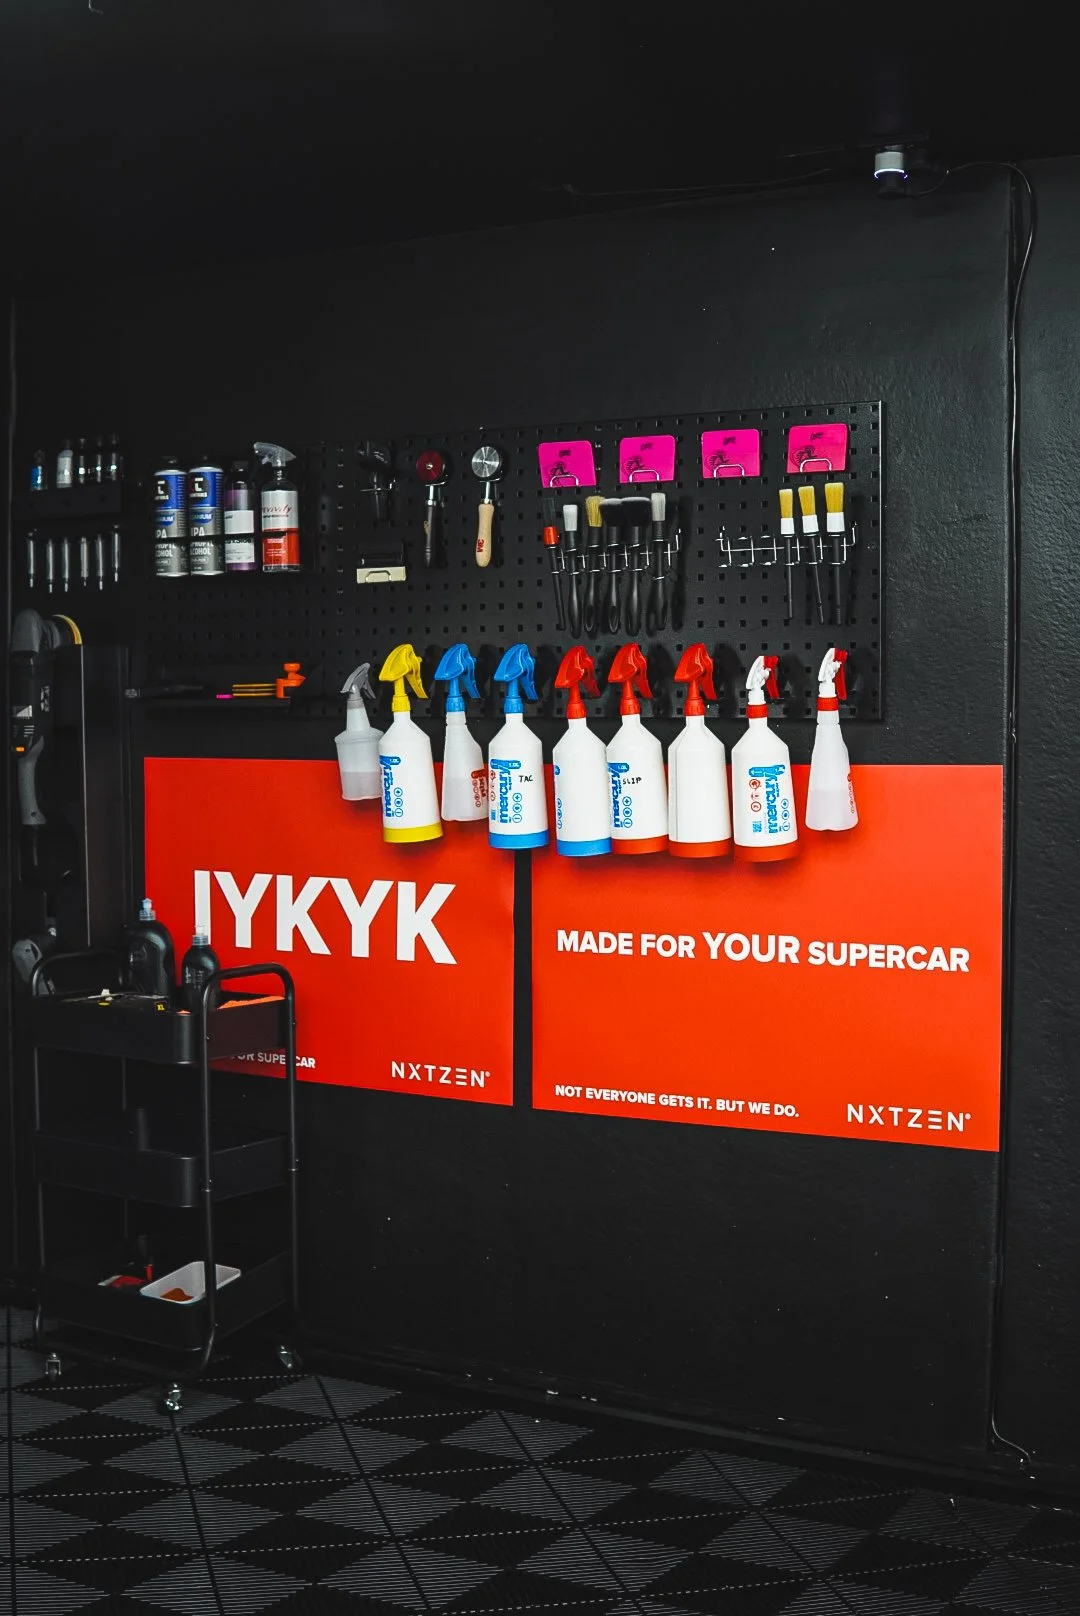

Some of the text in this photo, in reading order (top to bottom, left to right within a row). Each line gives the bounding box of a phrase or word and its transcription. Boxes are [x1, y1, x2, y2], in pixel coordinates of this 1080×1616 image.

[499, 765, 511, 823] mercury
[518, 774, 534, 783] TAC
[611, 767, 621, 828] mercury
[622, 776, 642, 785] SLIP
[765, 773, 779, 834] mercury
[194, 870, 458, 966] IYKYK
[557, 929, 970, 973] MADE FOR YOUR SUPERCAR
[257, 1052, 316, 1069] SUPECAR
[555, 1084, 800, 1118] NOT EVERYONE GETS IT. BUT WE DO.
